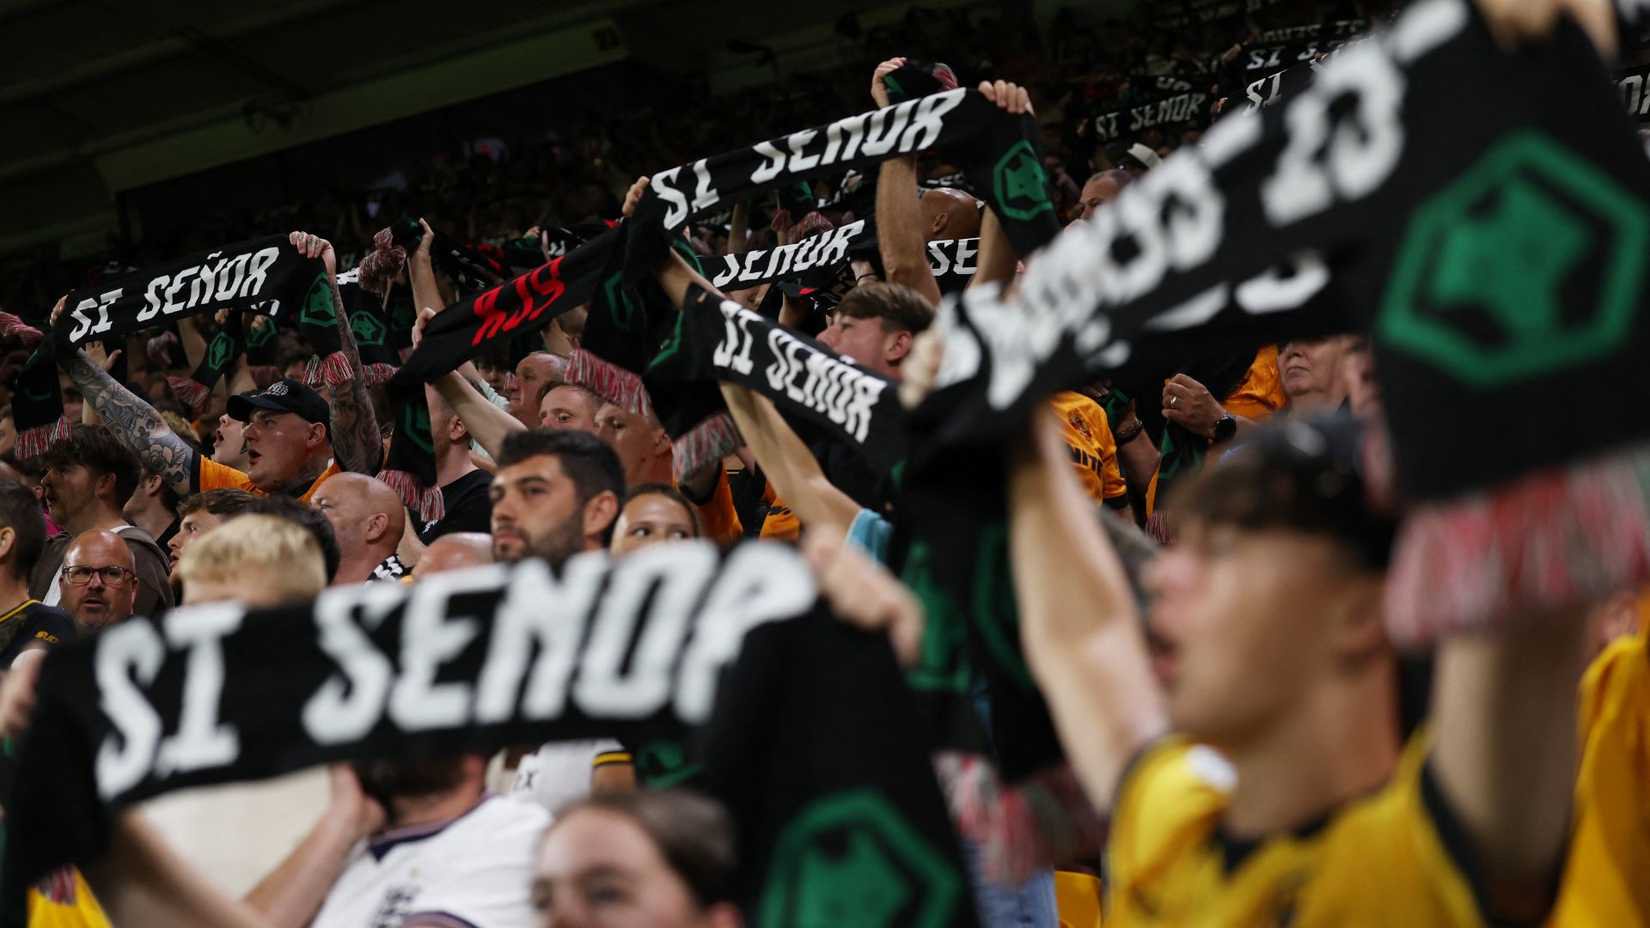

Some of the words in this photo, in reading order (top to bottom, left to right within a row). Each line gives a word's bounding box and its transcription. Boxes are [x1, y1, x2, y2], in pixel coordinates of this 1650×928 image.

[652, 158, 720, 230] SI
[69, 288, 125, 342] SI
[136, 246, 280, 323] SEÑOR
[713, 299, 767, 376] SI
[95, 602, 245, 800] SI
